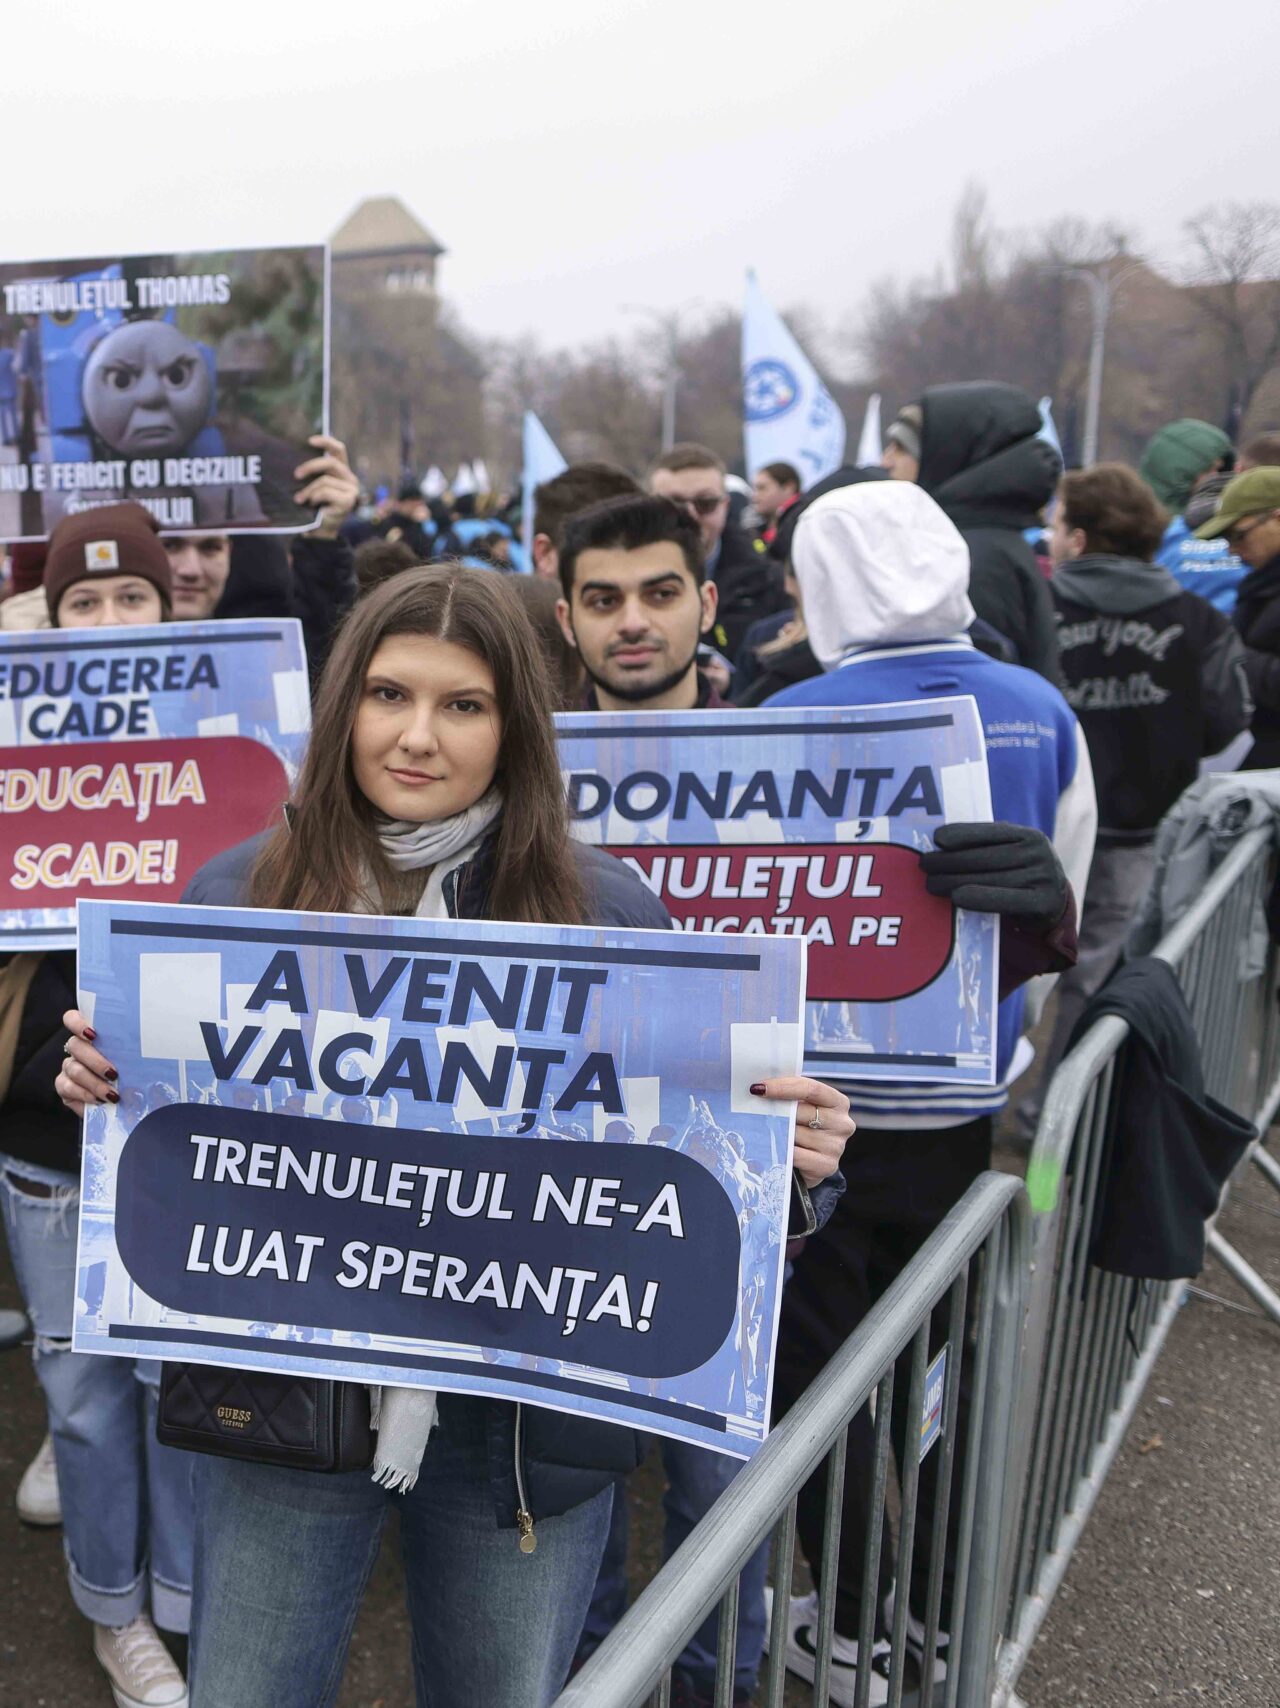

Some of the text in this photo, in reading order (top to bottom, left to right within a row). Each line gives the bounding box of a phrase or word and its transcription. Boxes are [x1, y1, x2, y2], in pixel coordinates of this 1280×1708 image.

[134, 274, 231, 309] THOMAS
[0, 455, 262, 491] NU E FERICIT CU DECIZIILE
[29, 700, 150, 739] CADE
[569, 765, 944, 838] DONANȚA
[10, 839, 178, 890] SCADE!
[620, 855, 883, 914] NULEȚUL
[849, 916, 903, 946] PE
[245, 950, 609, 1035] A VENIT
[199, 1022, 624, 1135] VACANȚA
[188, 1134, 687, 1240] TRENULEȚUL NE-A
[185, 1224, 662, 1337] LUAT SPERANȚA!
[217, 1406, 252, 1422] GUESS
